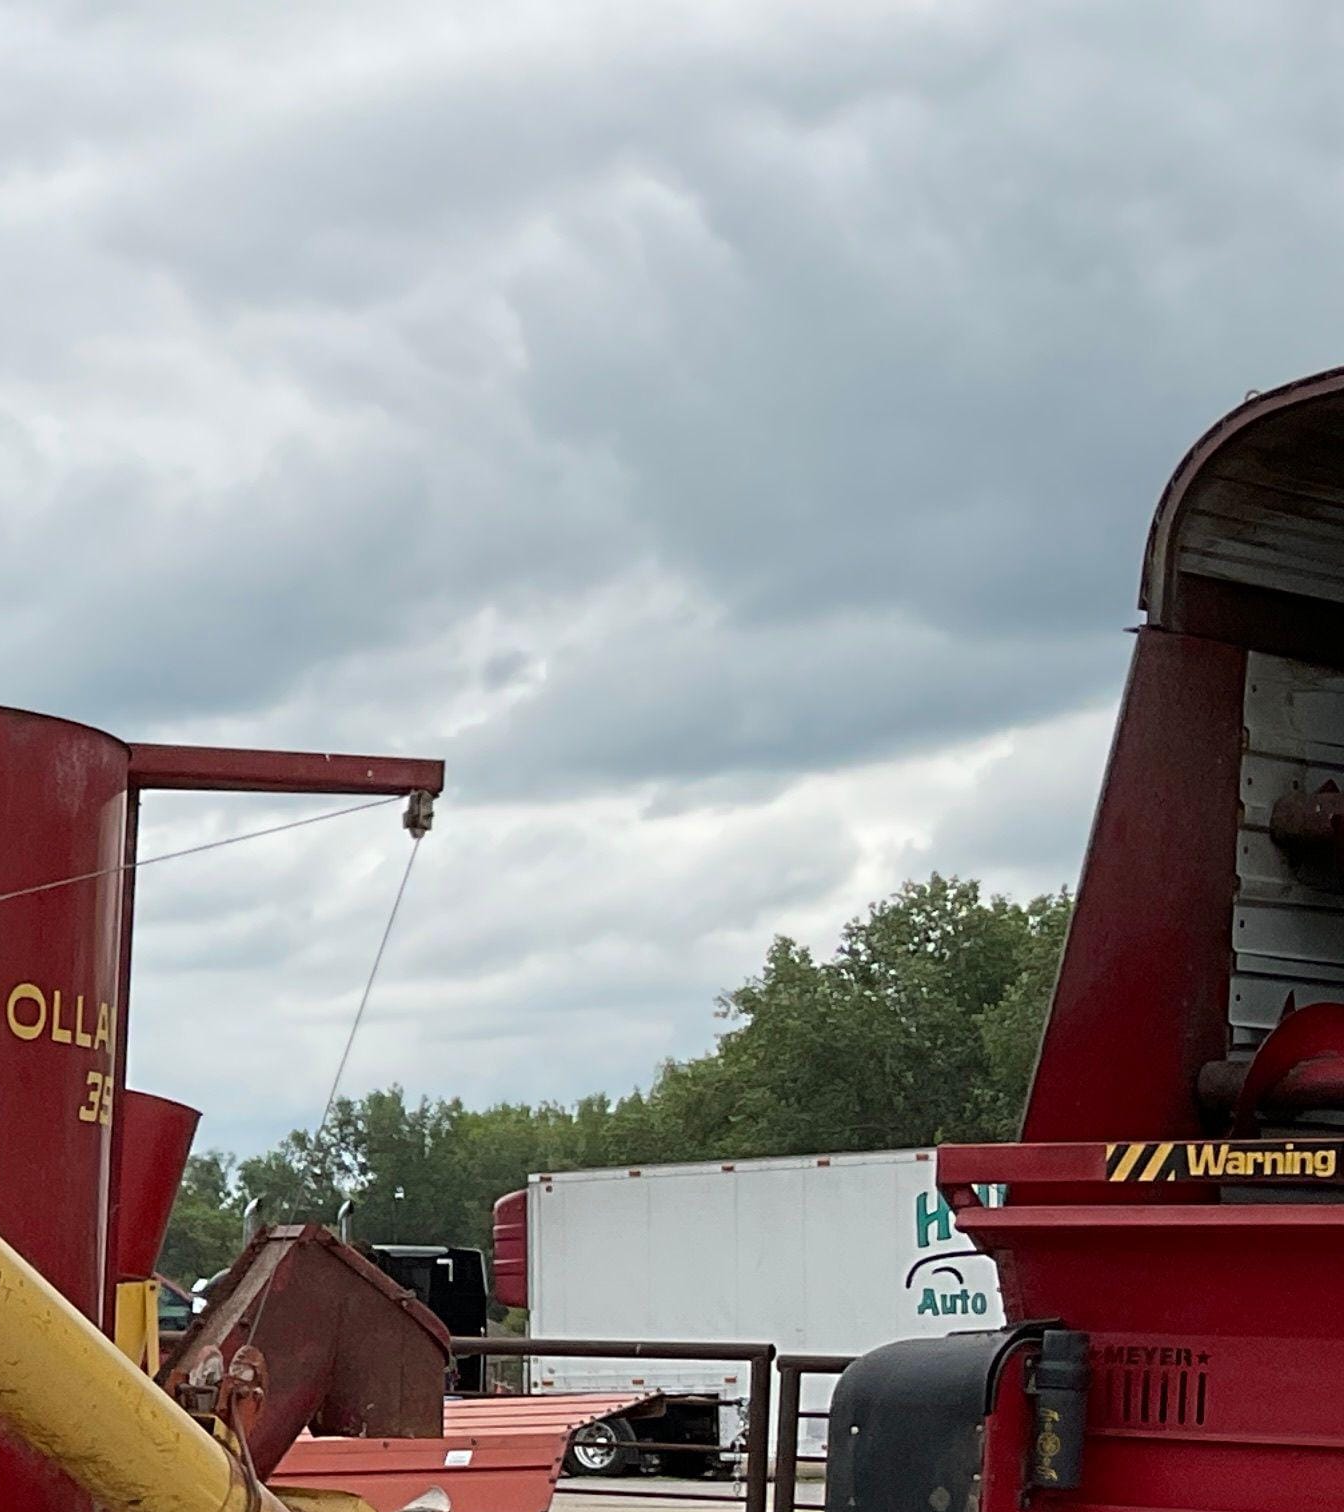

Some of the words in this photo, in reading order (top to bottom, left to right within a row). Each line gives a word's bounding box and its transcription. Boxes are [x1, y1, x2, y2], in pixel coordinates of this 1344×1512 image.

[1186, 1143, 1337, 1178] Warning
[917, 1287, 988, 1316] Auto
[1103, 1345, 1193, 1367] MEYER
